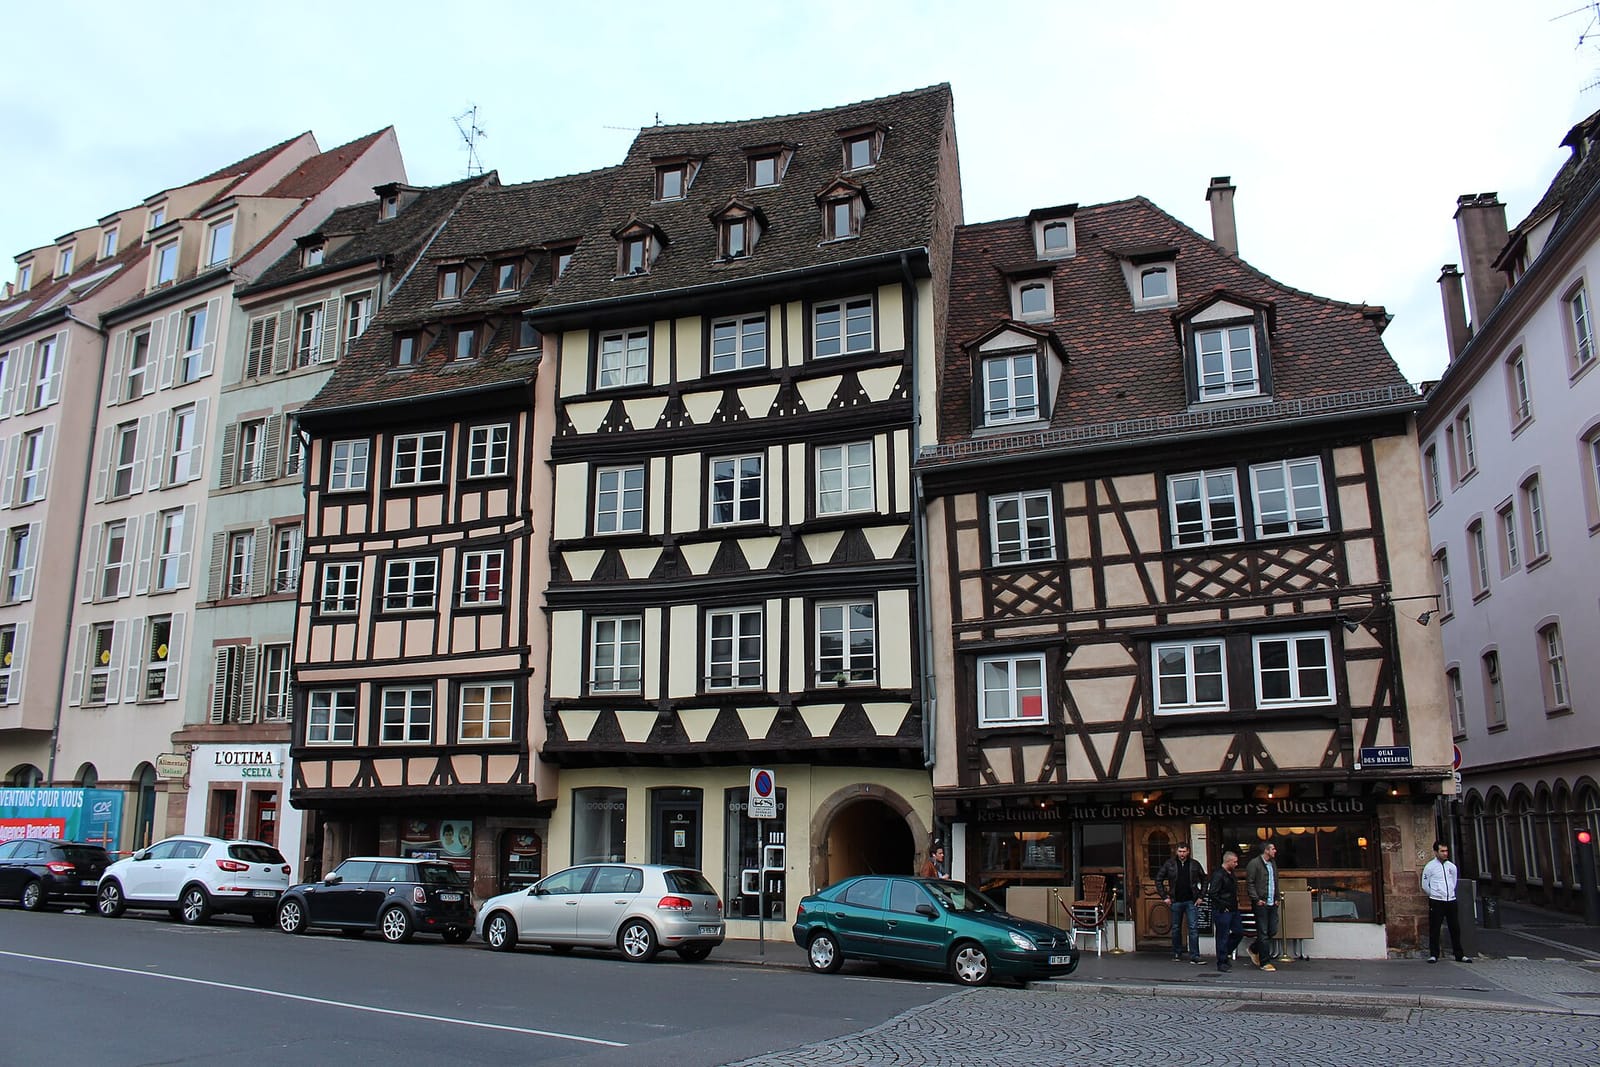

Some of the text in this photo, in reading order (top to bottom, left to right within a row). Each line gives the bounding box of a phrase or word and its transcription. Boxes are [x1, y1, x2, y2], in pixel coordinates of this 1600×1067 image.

[214, 751, 273, 765] L'OTTIMA
[241, 767, 272, 777] SCELTA
[36, 790, 60, 808] POUR
[61, 790, 84, 808] VOUS
[977, 807, 1061, 822] Restaurant
[1101, 804, 1146, 818] Trois
[1153, 800, 1269, 817] Chevaliers
[1276, 799, 1364, 814] Winstub
